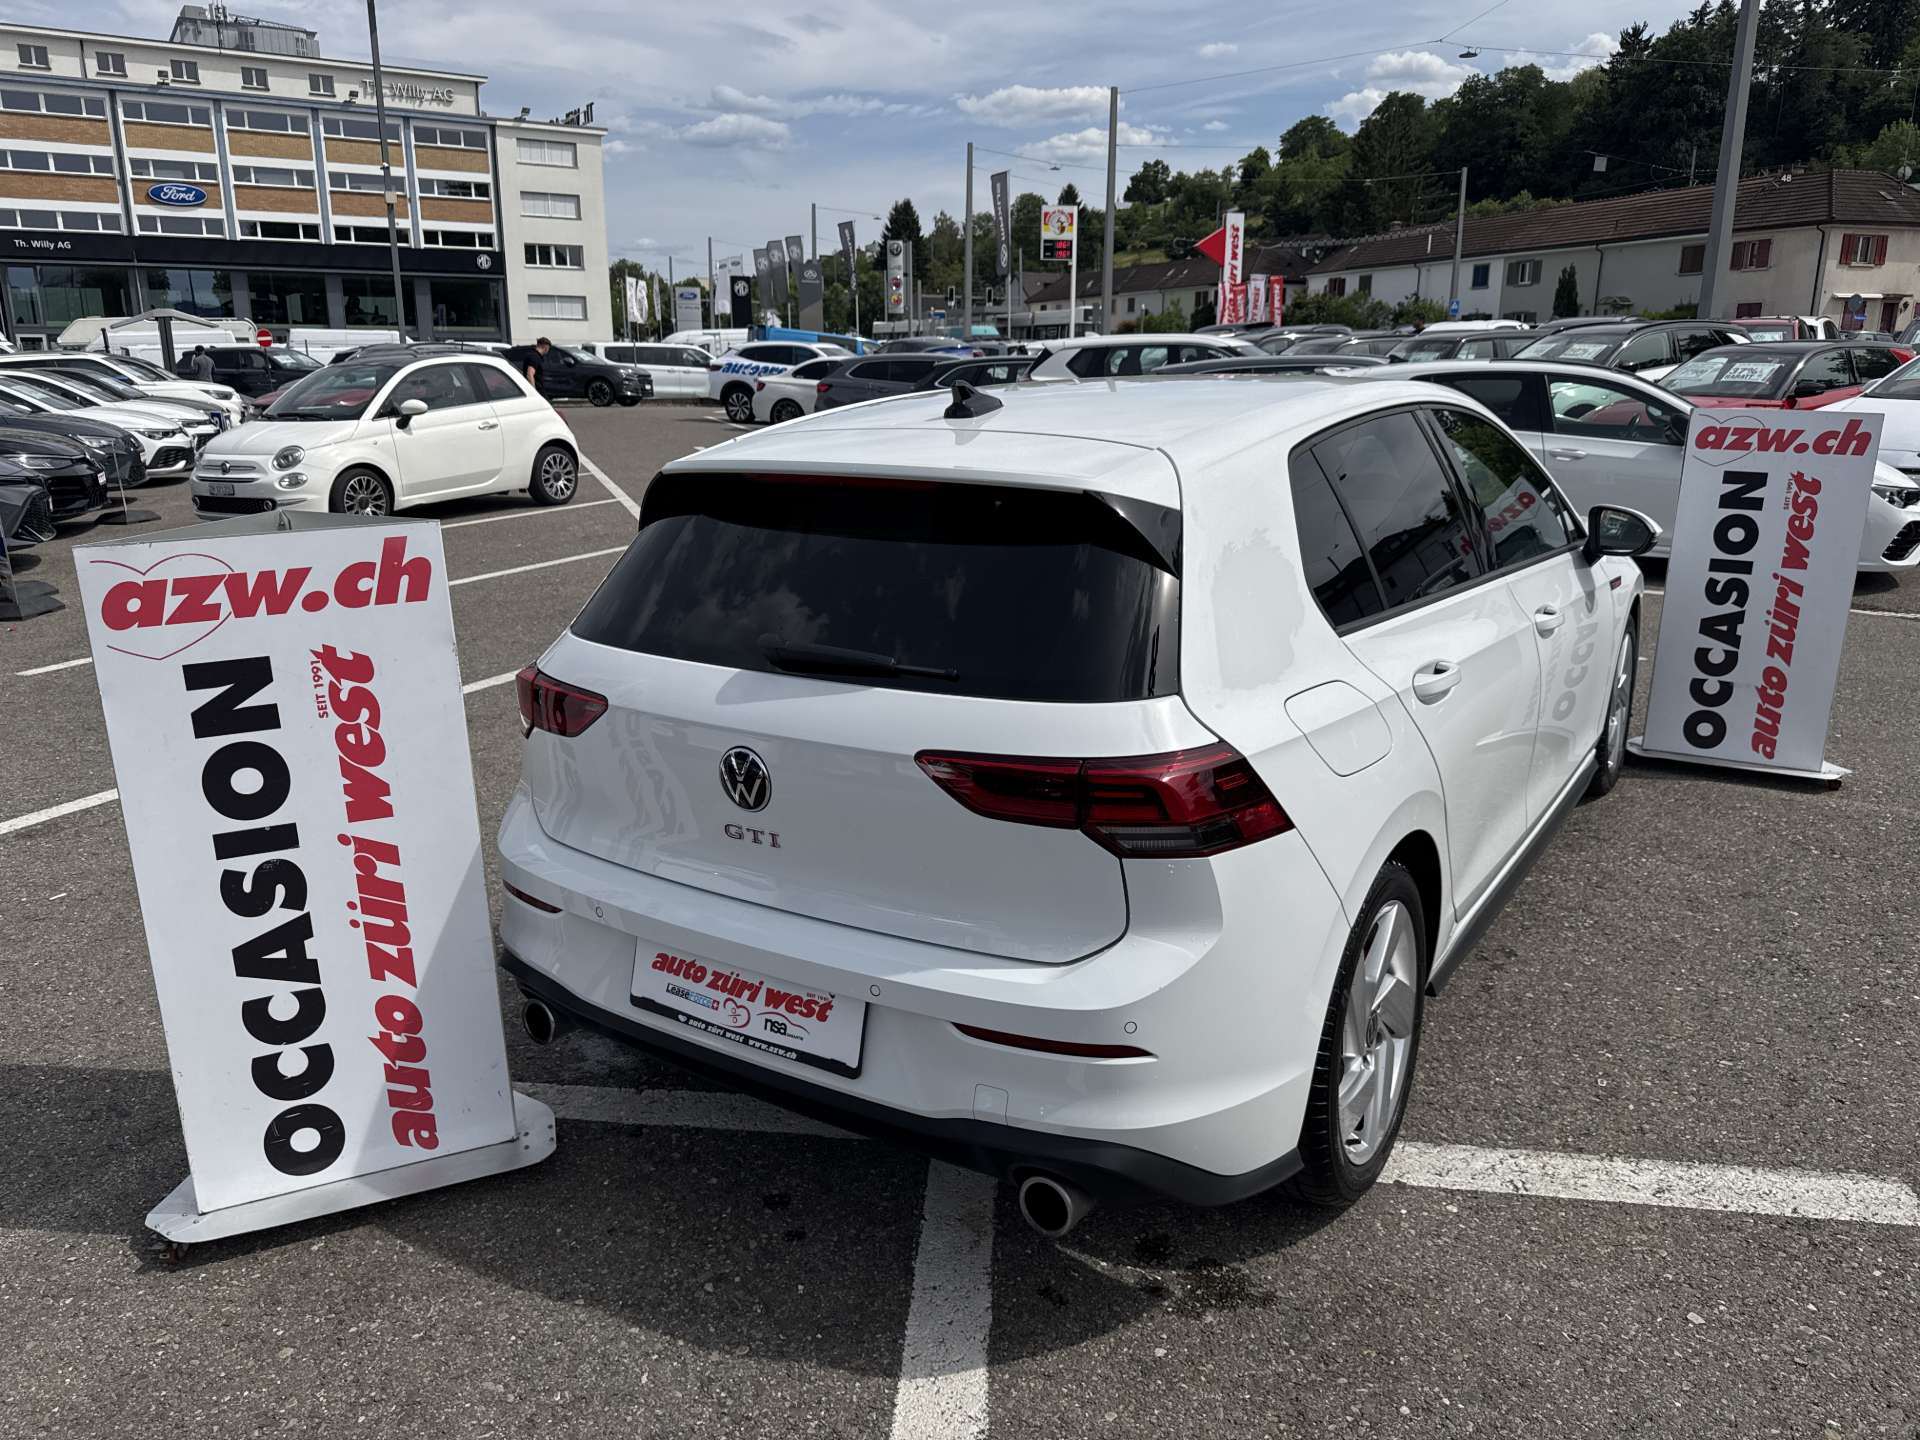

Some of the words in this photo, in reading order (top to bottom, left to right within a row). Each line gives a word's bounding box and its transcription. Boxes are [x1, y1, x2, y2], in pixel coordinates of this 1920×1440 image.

[391, 82, 427, 99] Willy
[433, 87, 455, 100] AG
[160, 184, 197, 202] Ford
[13, 239, 29, 248] Th.
[30, 239, 54, 250] Willy
[56, 241, 72, 249] AG
[1230, 223, 1240, 261] west
[1695, 418, 1872, 457] azw.ch
[1781, 470, 1822, 570] west
[101, 535, 433, 631] azw.ch
[1682, 470, 1769, 750] OCCASION
[1764, 572, 1804, 668] züri
[310, 659, 325, 690] 1991
[308, 642, 395, 824] west
[316, 693, 329, 720] SEIT
[1751, 665, 1788, 760] auto
[724, 823, 782, 849] GTI
[182, 655, 346, 1177] OCCASION
[336, 832, 418, 989] züri
[651, 951, 708, 984] auto
[705, 969, 765, 1004] züri
[759, 987, 836, 1023] west
[688, 1018, 706, 1030] auto
[725, 1031, 745, 1043] west
[747, 1038, 798, 1060] www.azw.ch
[764, 1018, 787, 1036] nsa
[367, 994, 440, 1151] auto
